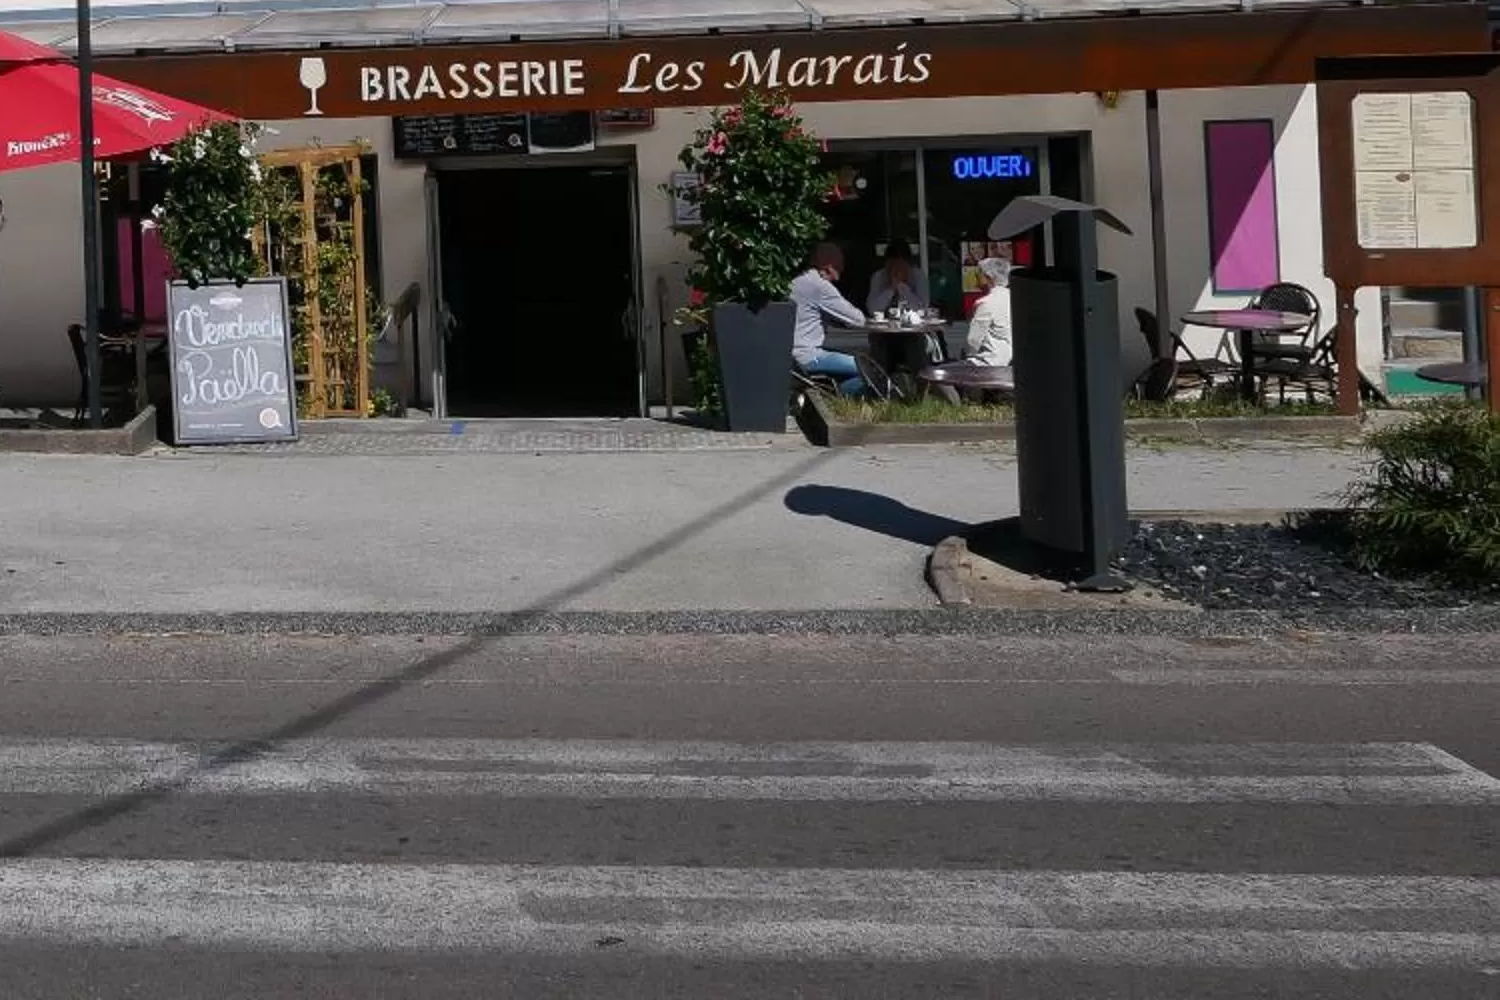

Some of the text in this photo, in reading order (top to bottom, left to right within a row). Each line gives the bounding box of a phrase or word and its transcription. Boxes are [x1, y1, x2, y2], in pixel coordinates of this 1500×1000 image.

[360, 42, 932, 102] BRASSERIE Les Marais
[178, 345, 287, 405] Paëlla
